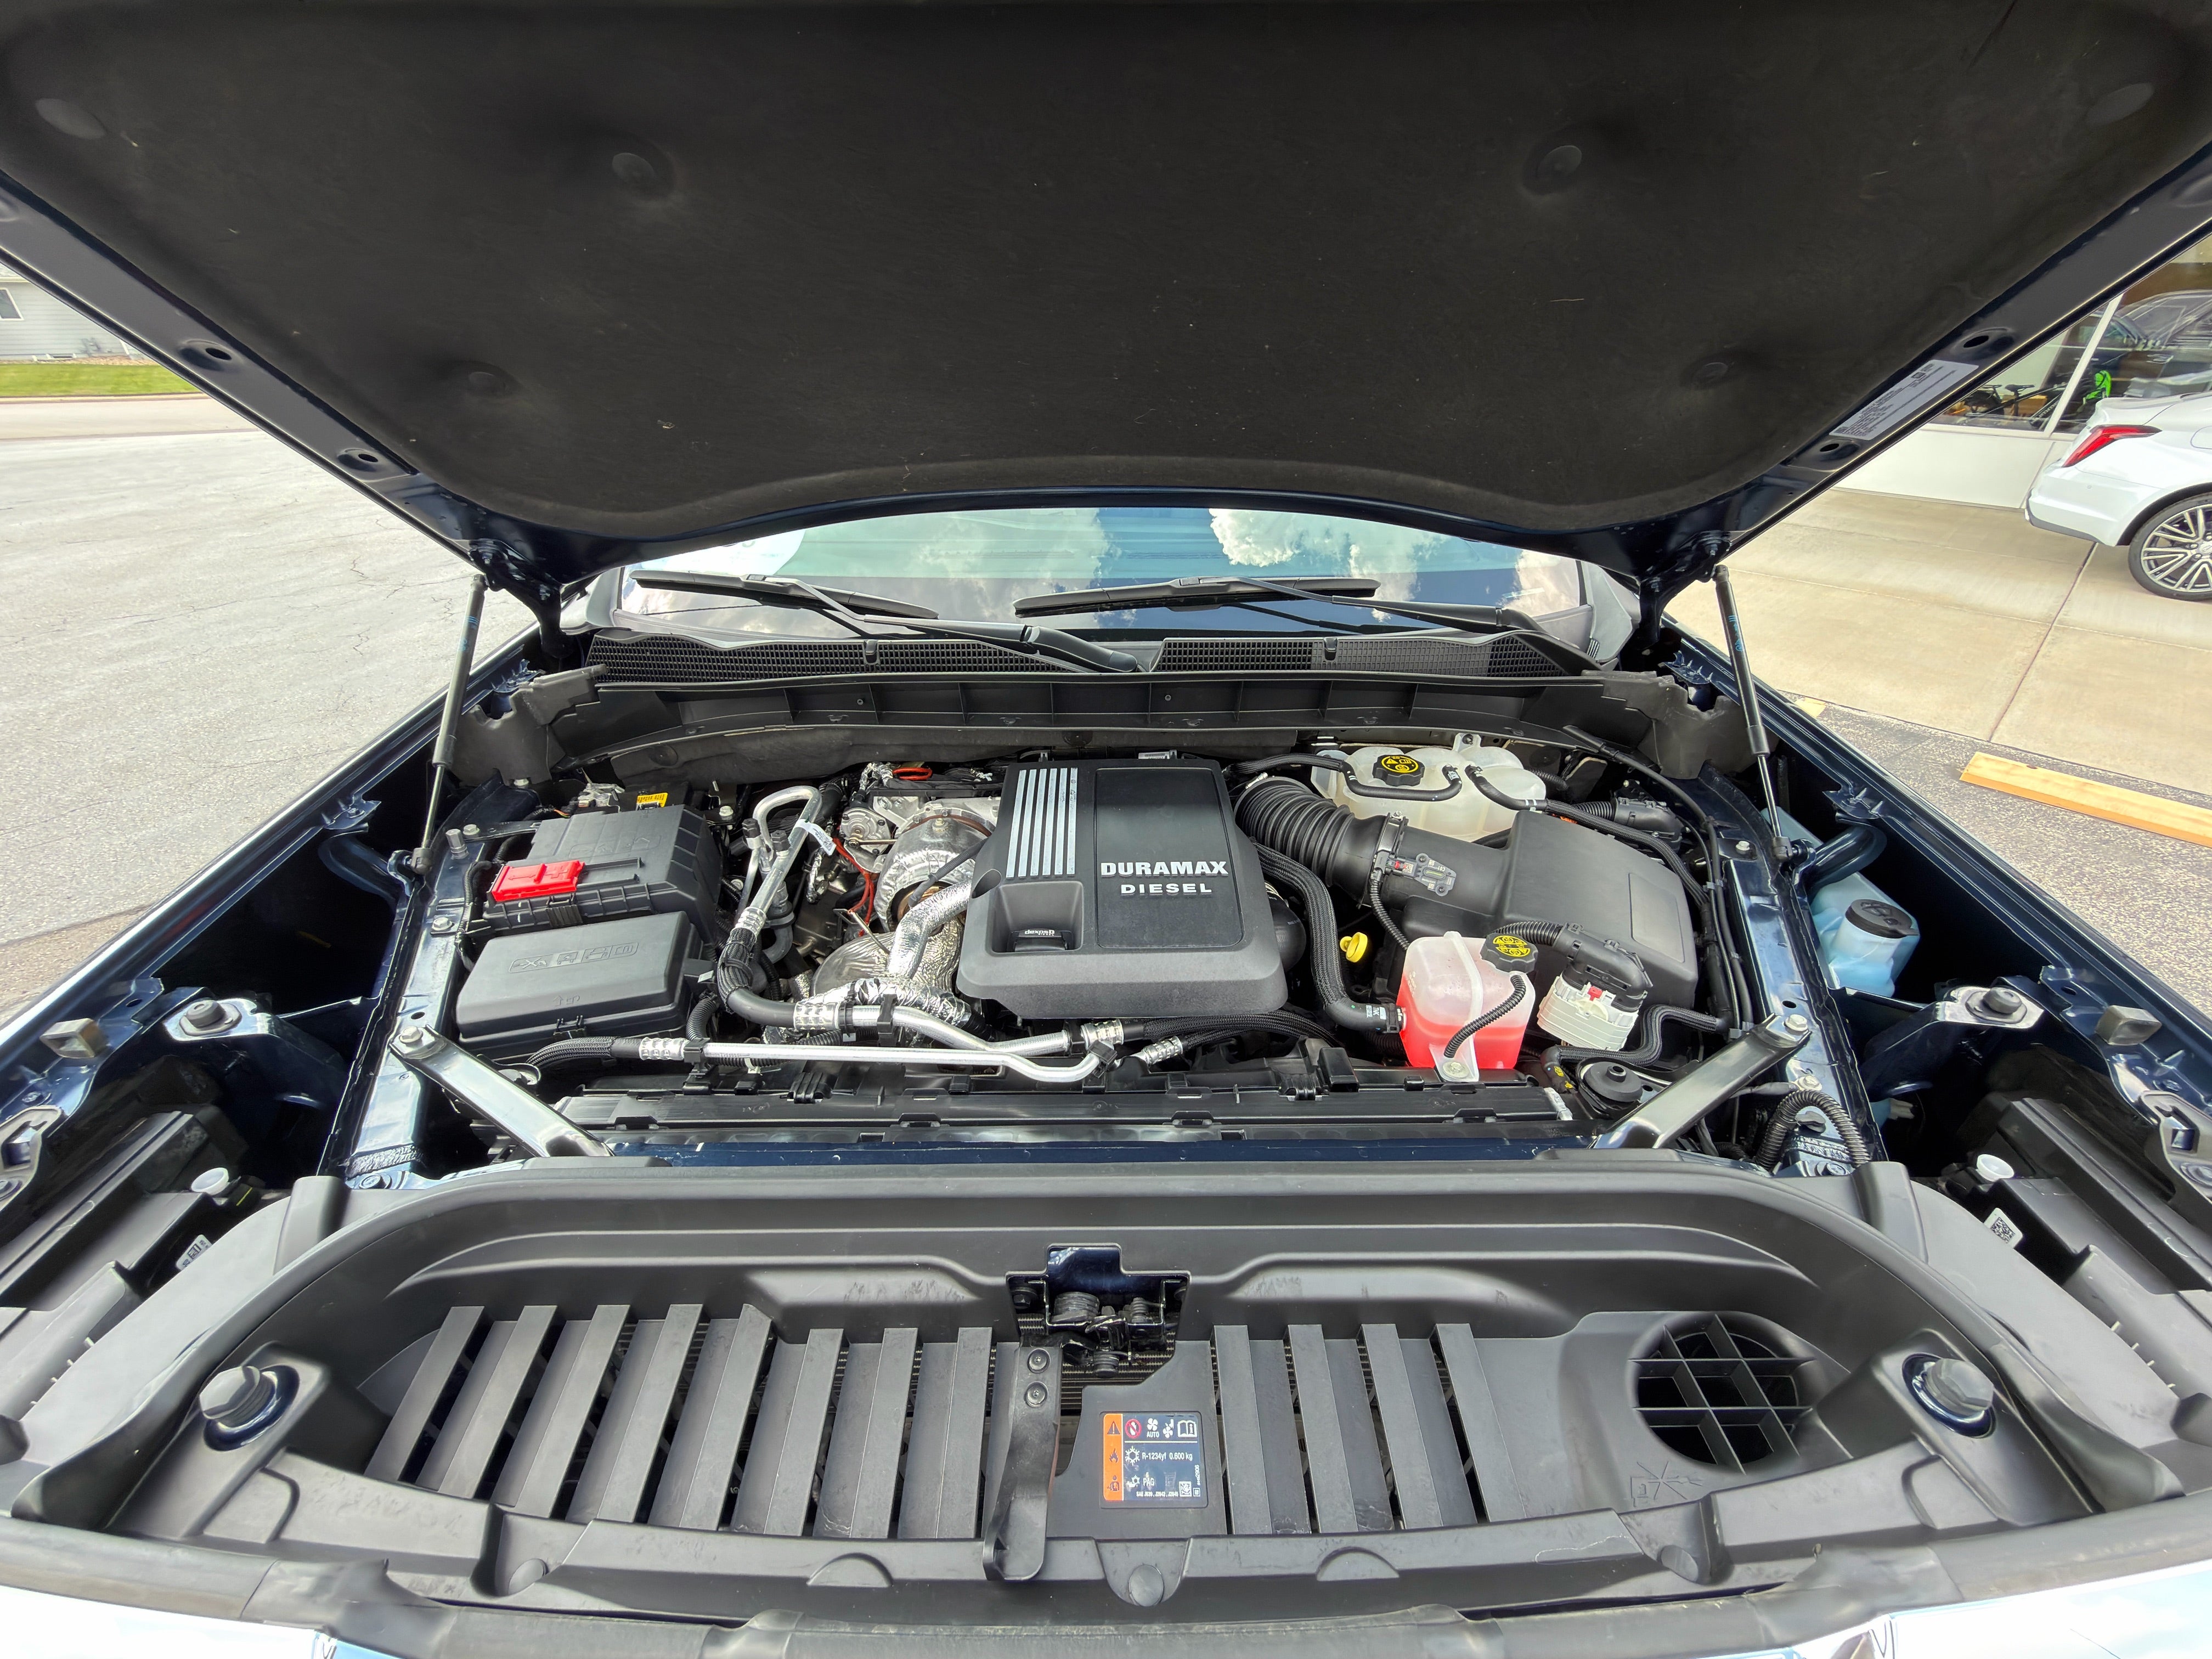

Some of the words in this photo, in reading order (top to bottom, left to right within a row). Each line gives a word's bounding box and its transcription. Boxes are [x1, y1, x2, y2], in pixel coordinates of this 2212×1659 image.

[1101, 861, 1228, 876] DURAMAX
[1121, 883, 1212, 895] DIESEL
[1142, 1452, 1166, 1461] R-1234yf
[1186, 1452, 1193, 1461] kg
[1143, 1477, 1155, 1487] PAG
